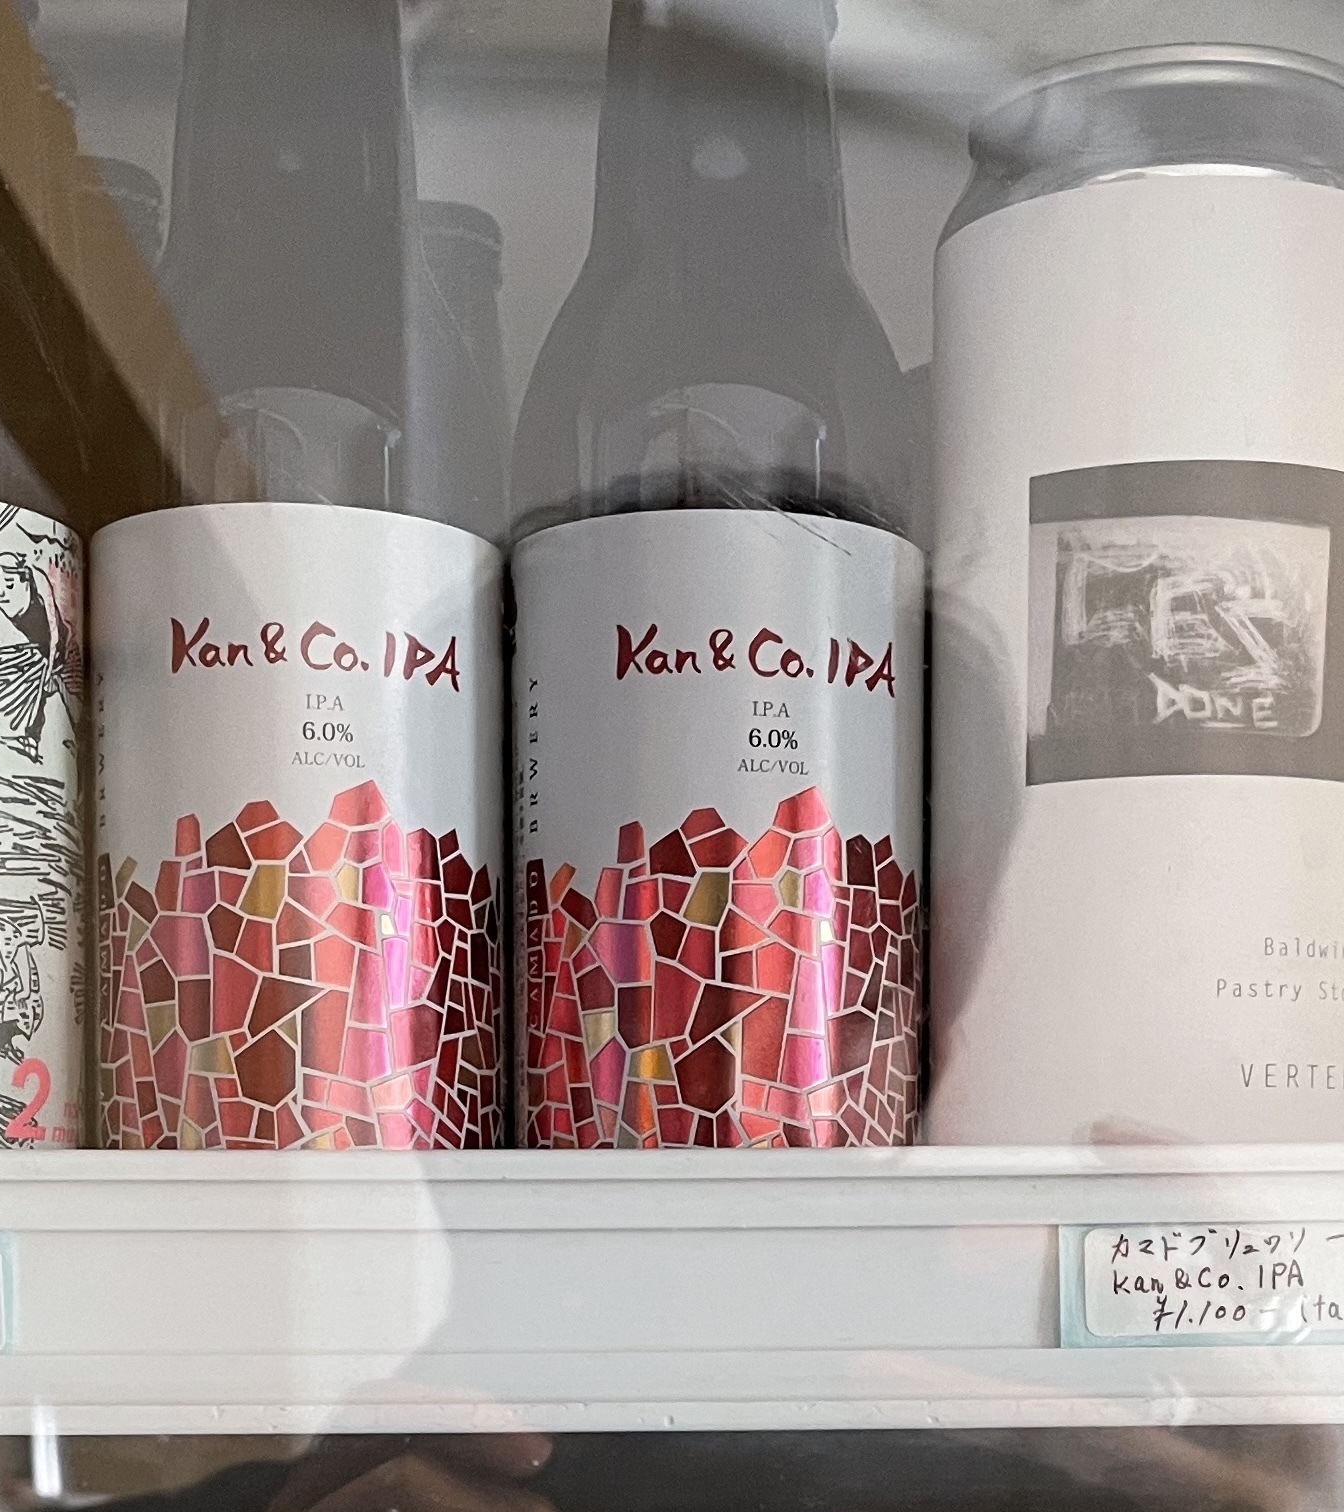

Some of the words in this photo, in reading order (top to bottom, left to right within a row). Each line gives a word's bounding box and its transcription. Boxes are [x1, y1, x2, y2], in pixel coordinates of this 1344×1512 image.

[171, 617, 254, 674] Kan
[260, 622, 287, 663] &
[300, 621, 369, 671] Co.
[383, 631, 460, 692] IPA
[616, 623, 701, 680] Kan
[709, 628, 736, 671] &
[748, 627, 814, 678] Co.
[827, 637, 896, 698] IPA
[301, 721, 354, 742] 6.0%
[748, 728, 798, 749] 6.0%
[291, 751, 366, 769] ALC/VOL
[529, 675, 540, 834] BRWERY
[737, 758, 809, 776] ALC/VOL
[1216, 978, 1302, 1003] Pastry
[1174, 1268, 1192, 1289] &
[1197, 1268, 1245, 1291] Co.
[1258, 1259, 1305, 1290] IPA
